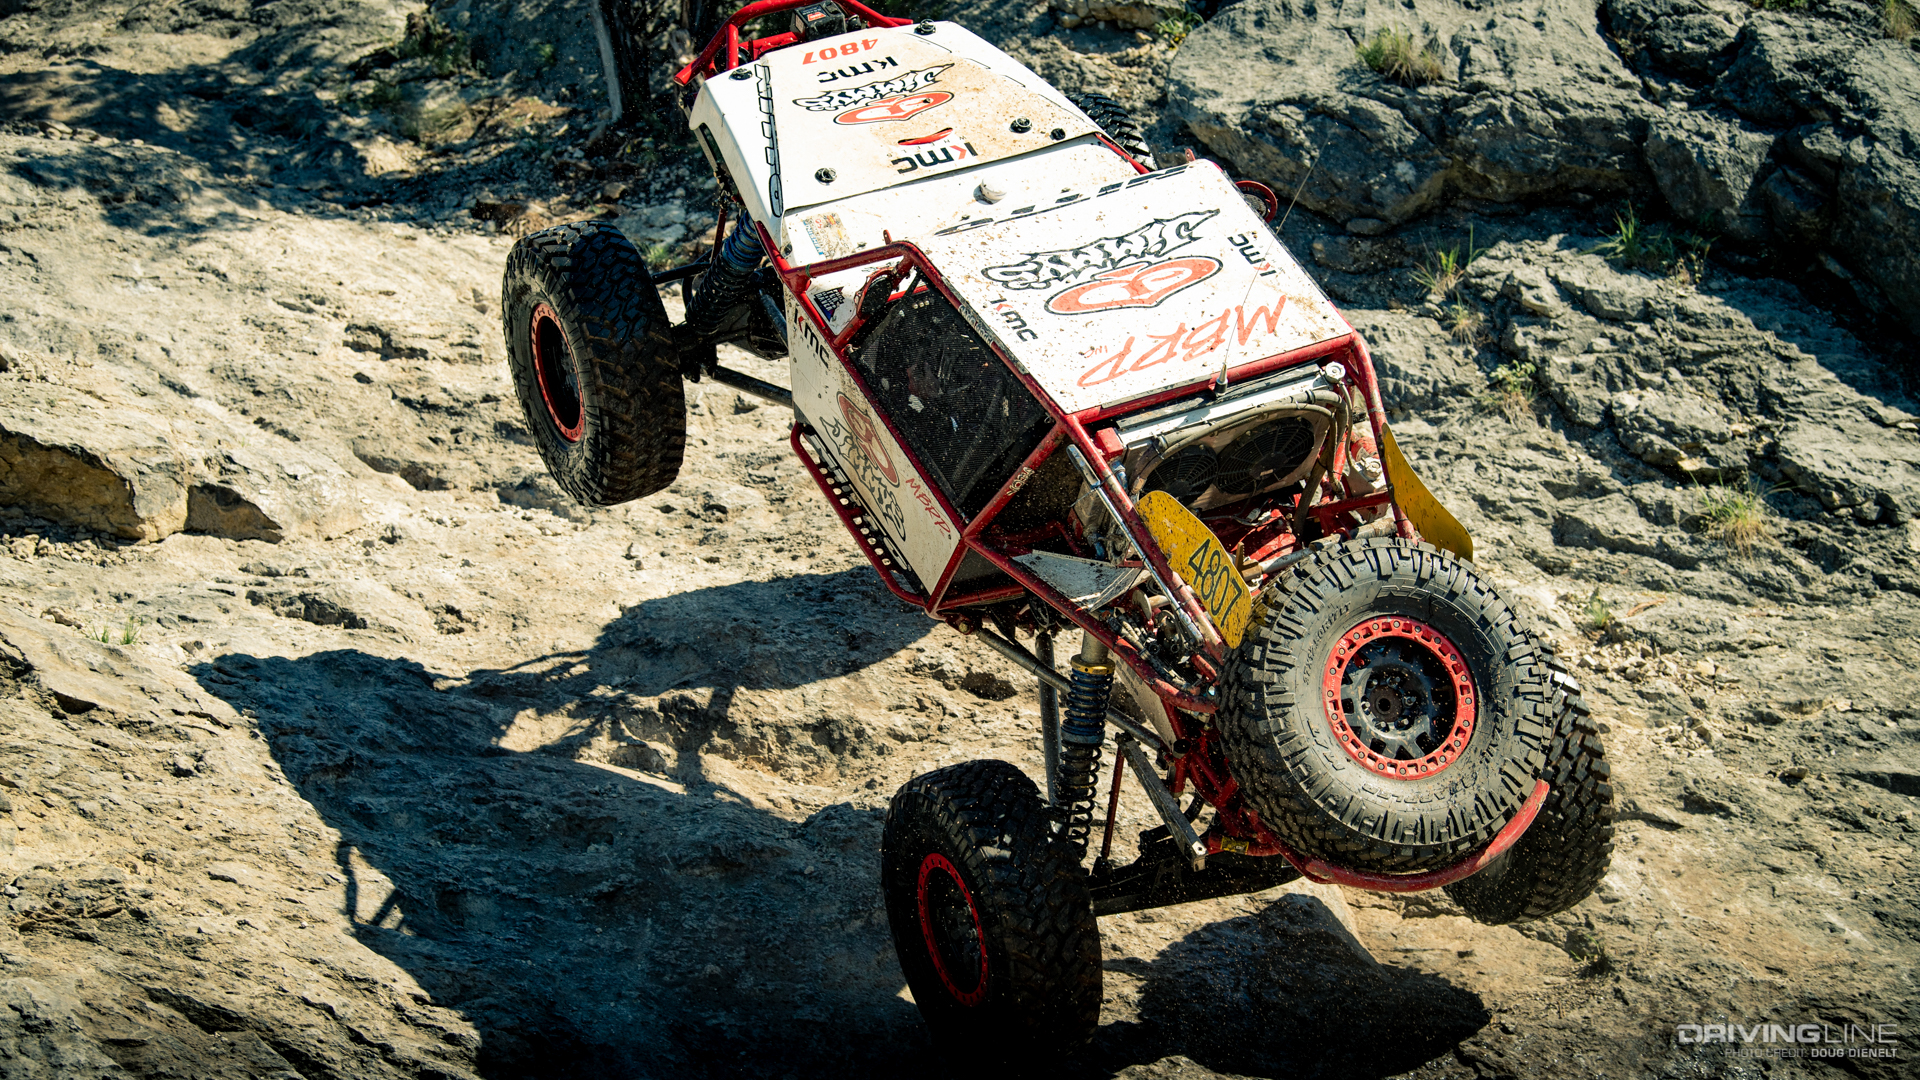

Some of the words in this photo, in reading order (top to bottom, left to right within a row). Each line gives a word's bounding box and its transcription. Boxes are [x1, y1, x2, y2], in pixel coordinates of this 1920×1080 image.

[802, 38, 878, 65] 4807
[817, 56, 899, 83] KMC
[891, 142, 979, 174] KMC
[1227, 233, 1277, 277] KMC
[794, 308, 831, 369] KMC
[990, 298, 1039, 342] KMC
[1076, 294, 1287, 387] MBRP
[906, 478, 951, 533] MBRP
[1188, 538, 1243, 628] 4807
